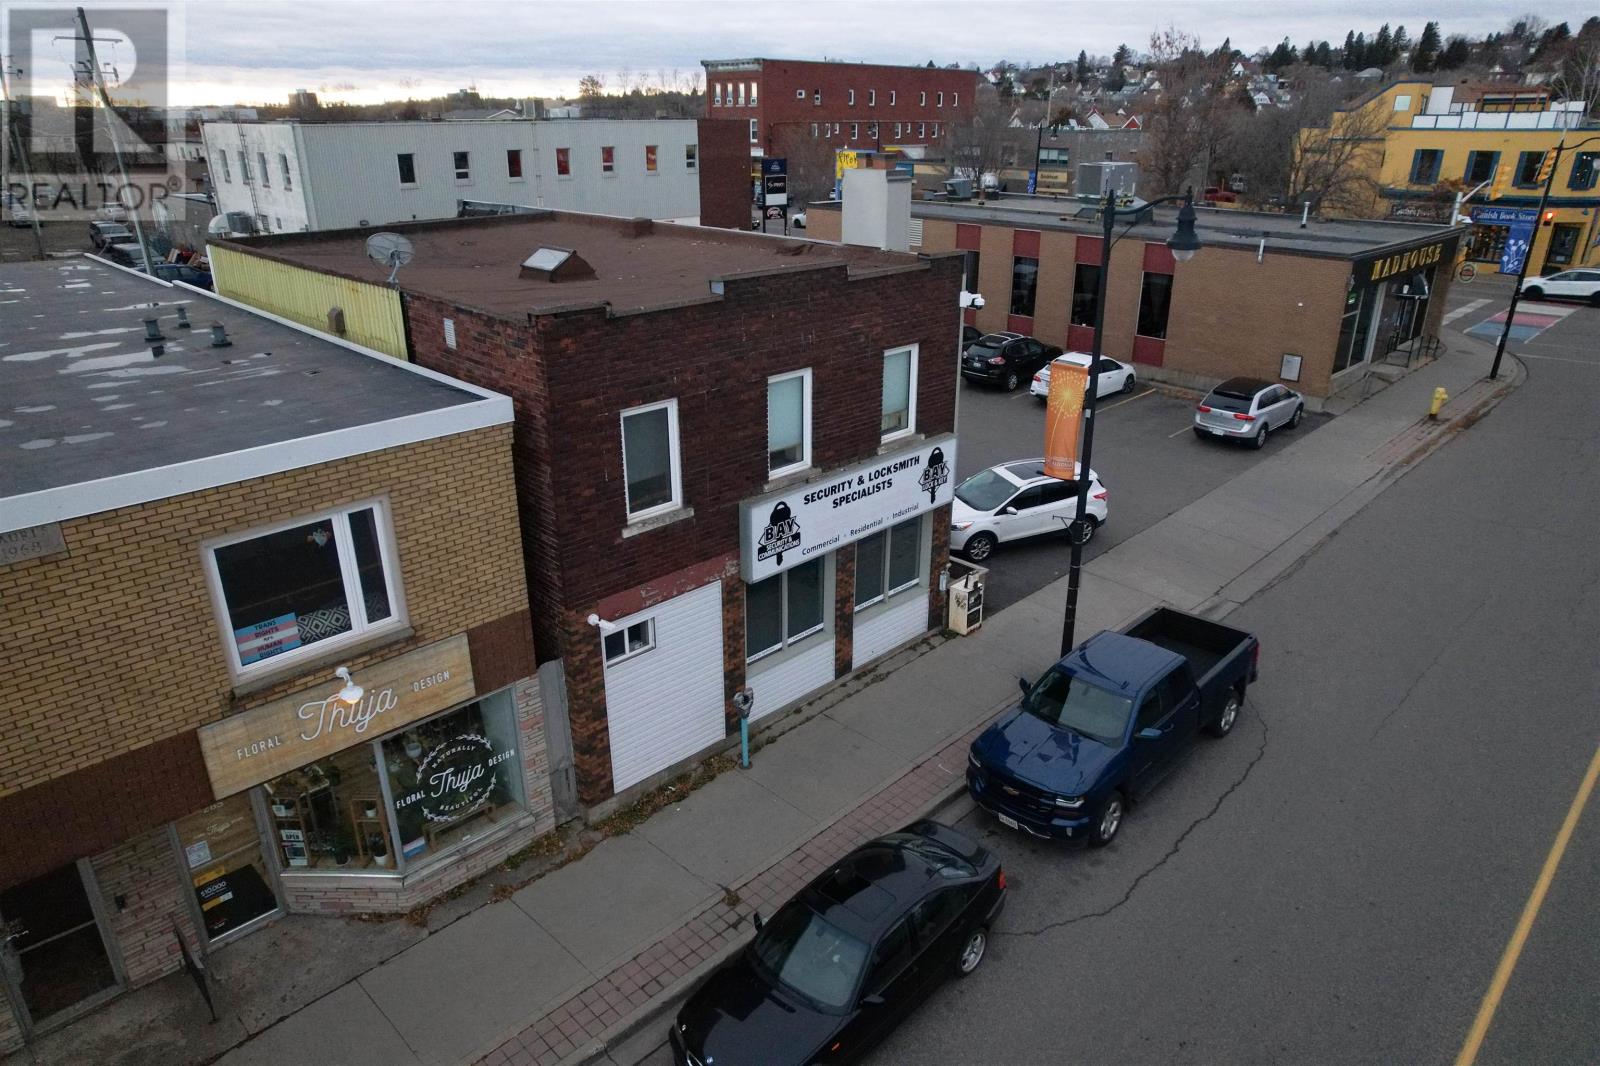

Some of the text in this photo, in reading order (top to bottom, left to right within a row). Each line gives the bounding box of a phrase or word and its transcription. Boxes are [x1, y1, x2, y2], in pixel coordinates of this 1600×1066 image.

[1371, 244, 1442, 280] MADHOUSE
[803, 456, 920, 505] SECURITY & LOCKSMITH
[924, 463, 945, 480] BAY
[832, 478, 893, 509] SPECIALISTS
[764, 517, 796, 543] BAY
[766, 538, 788, 551] SECURITY
[802, 502, 919, 556] Commercial Residential Industrial
[758, 540, 801, 560] COMMUNICATIONS
[236, 670, 450, 760] FLORAL Thuja DESIGN
[431, 745, 476, 769] NATURALLY
[396, 748, 515, 809] FLORAL Thuja DESIGN
